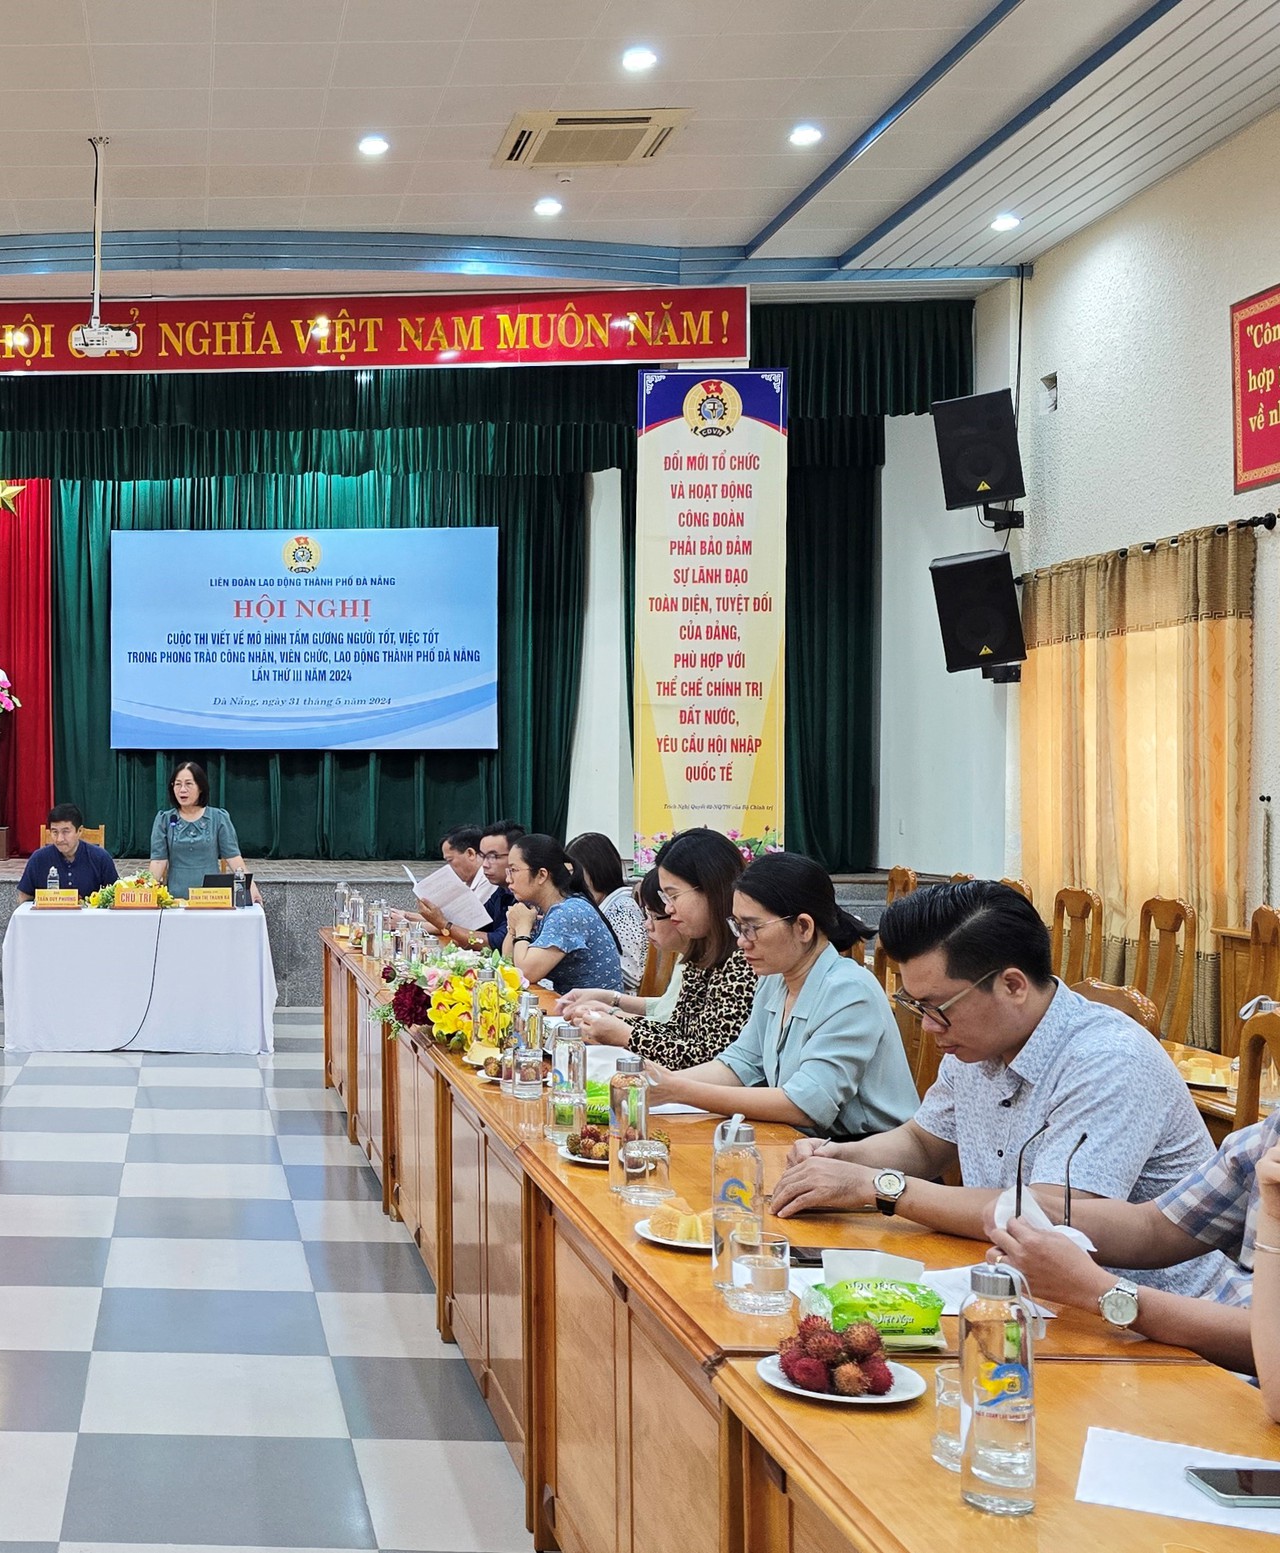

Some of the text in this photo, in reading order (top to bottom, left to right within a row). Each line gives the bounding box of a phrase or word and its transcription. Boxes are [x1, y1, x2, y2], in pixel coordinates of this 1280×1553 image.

[67, 307, 146, 358] CỦ
[158, 313, 282, 357] NGHĨA
[291, 309, 383, 361] VIỆT
[397, 315, 484, 354] NAM
[497, 302, 612, 350] MUÔN
[1248, 367, 1275, 394] hợp
[1249, 402, 1265, 432] về
[664, 450, 760, 470] ĐỔI MỚI TỔ CHỨC
[671, 481, 752, 502] VÀ HOẠT ĐỘNG
[679, 509, 744, 527] CÔNG ĐOÀN
[210, 576, 229, 587] LIÊN
[232, 576, 256, 587] ĐOÀN
[259, 578, 274, 587] LAO
[277, 576, 301, 588] ĐỘNG
[304, 576, 332, 586] THÀNH
[336, 575, 353, 586] PHỐ
[356, 576, 368, 586] ĐÀ
[234, 594, 371, 623] HỘI NGHỊ
[649, 591, 772, 615] TOÀN DIỆN, TUYỆT ĐỐI
[167, 630, 191, 647] CUỘC
[194, 633, 208, 644] THI
[211, 629, 230, 644] VIẾT
[247, 630, 261, 644] MÔ
[265, 630, 286, 644] HÌNH
[290, 629, 309, 644] TẤM
[312, 630, 344, 644] GƯƠNG
[347, 629, 376, 644] NGƯỜI
[378, 628, 396, 645] TỐT,
[399, 629, 420, 646] VIỆC
[423, 628, 439, 644] TỐT
[128, 651, 157, 663] TRONG
[160, 651, 191, 663] PHONG
[194, 649, 217, 663] TRÀO
[220, 649, 245, 663] CÔNG
[248, 649, 277, 665] NHÂN,
[280, 649, 300, 663] VIÊN
[304, 648, 331, 664] CHỨC,
[334, 650, 351, 662] LAO
[354, 648, 380, 665] ĐỘNG
[383, 648, 413, 662] THÀNH
[416, 646, 435, 662] PHỐ
[438, 648, 450, 662] ĐÀ
[273, 667, 291, 682] THỨ
[293, 670, 302, 682] III
[305, 667, 326, 682] NĂM
[330, 670, 352, 682] 2024
[657, 675, 763, 700] THỂ CHẾ CHÍNH TRỊ
[262, 697, 285, 707] ngày
[288, 697, 300, 705] 31
[303, 697, 332, 707] tháng
[344, 697, 366, 705] năm
[369, 697, 392, 705] 2024
[679, 705, 739, 726] ĐẤT NƯỚC,
[686, 761, 733, 782] QUỐC TẾ
